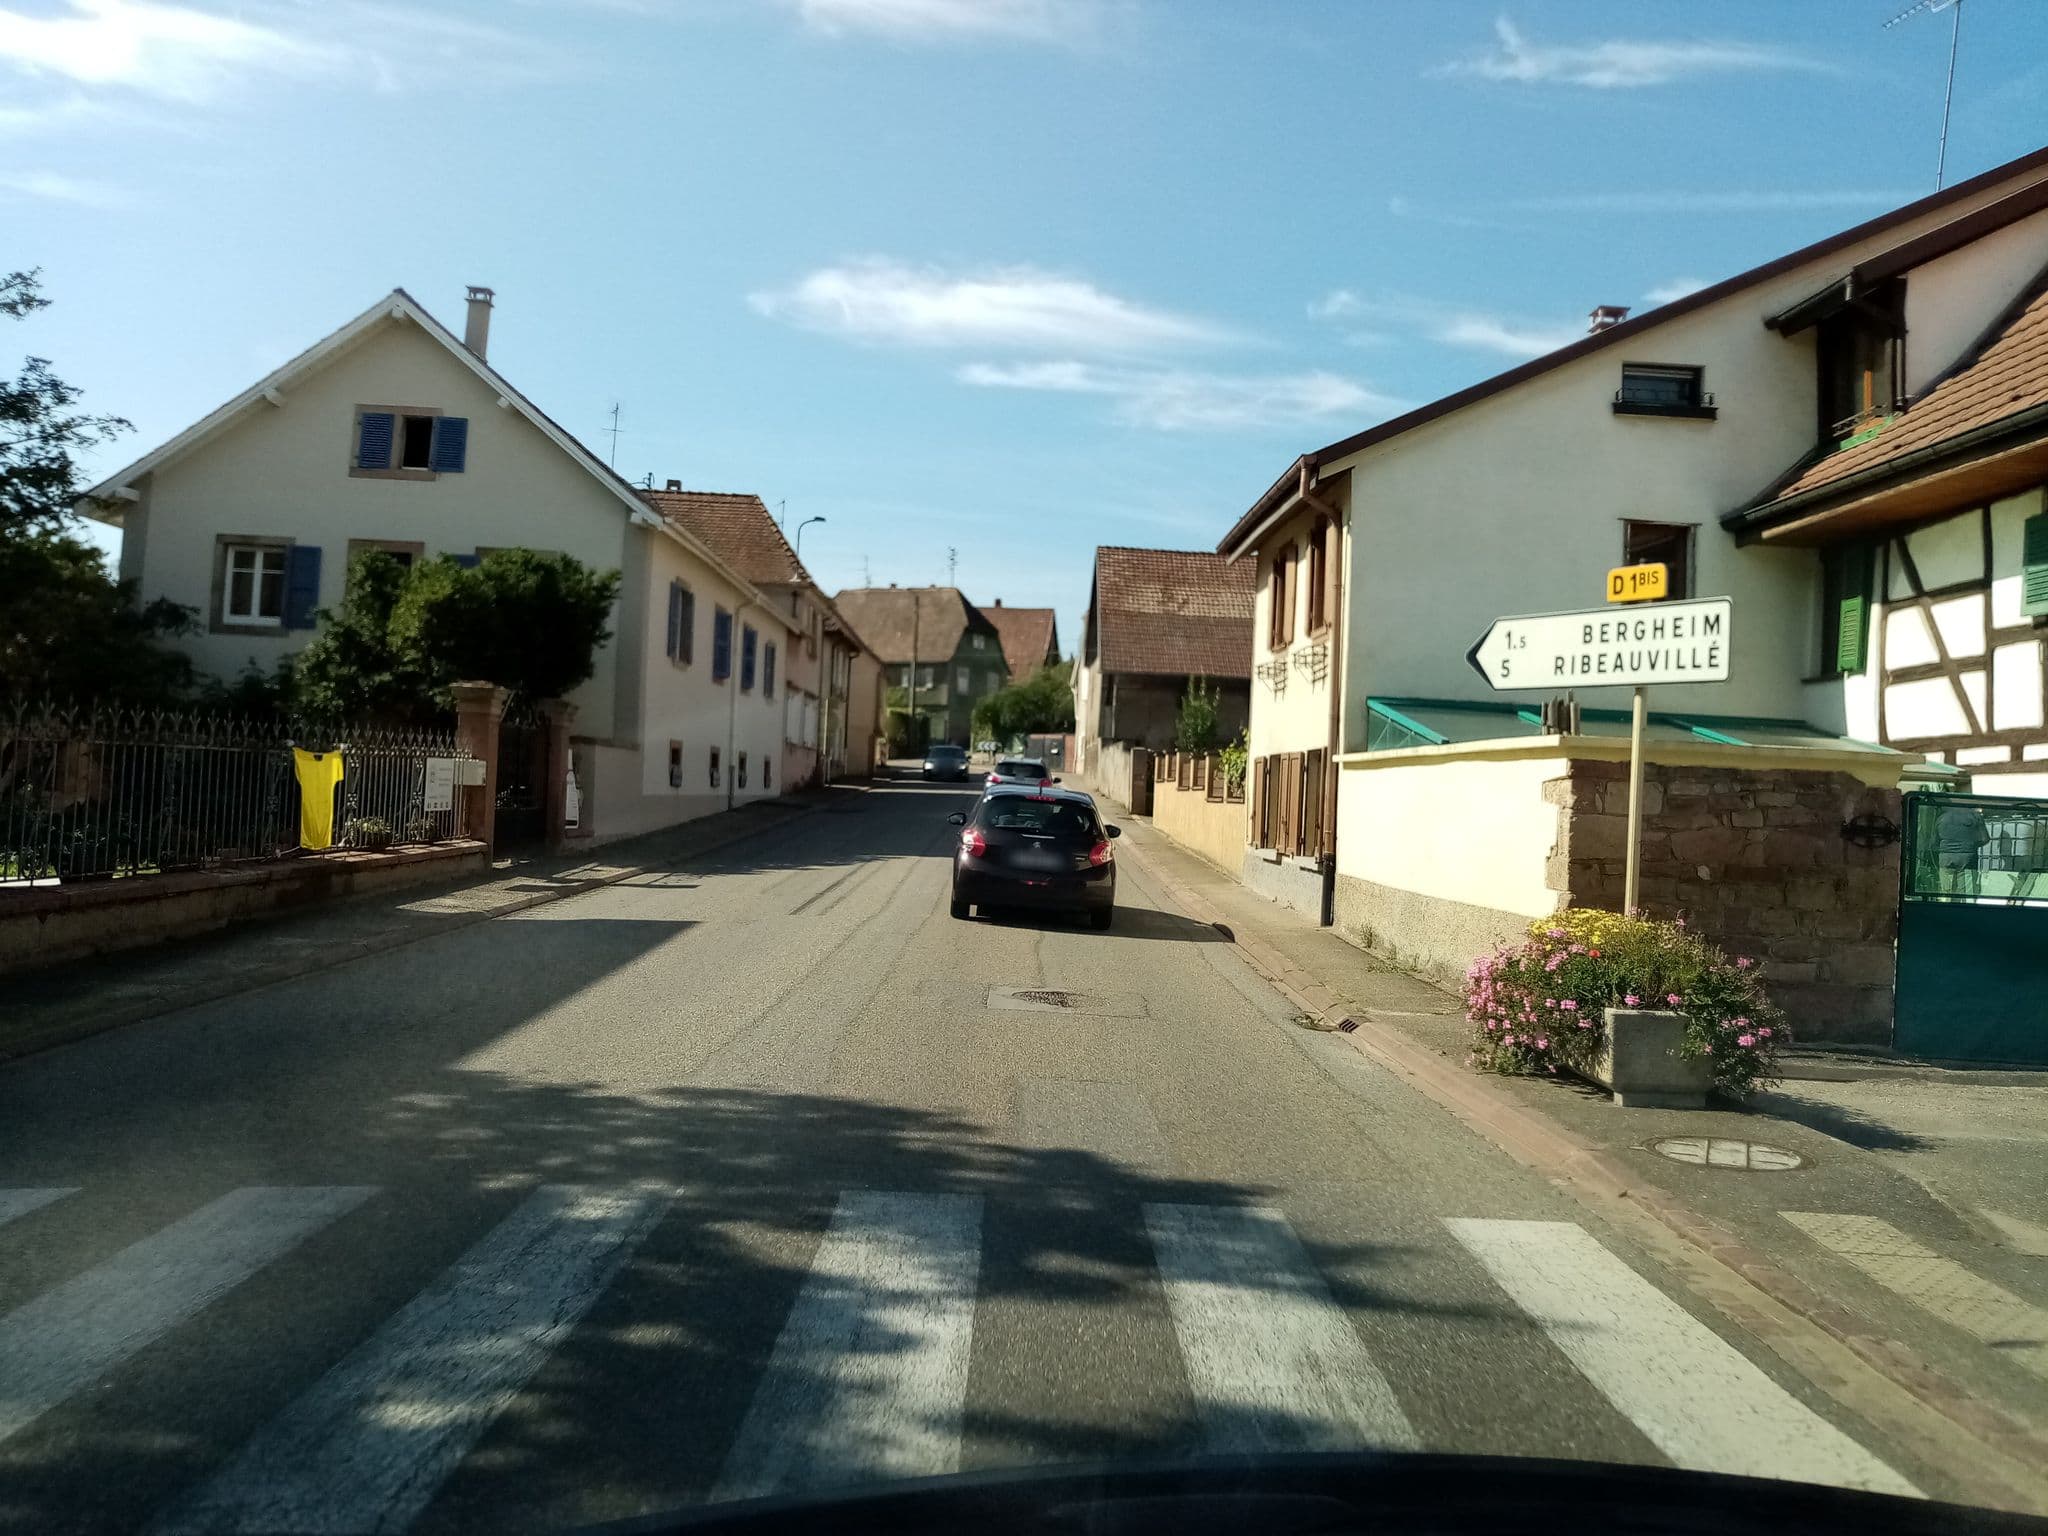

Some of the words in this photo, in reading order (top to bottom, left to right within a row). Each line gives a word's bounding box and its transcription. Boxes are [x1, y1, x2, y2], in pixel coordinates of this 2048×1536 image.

[1613, 575, 1624, 595] D
[1583, 614, 1721, 643] BERGHEIM
[1501, 659, 1510, 678] 5
[1554, 641, 1720, 675] RIBEAUVILLÉ
